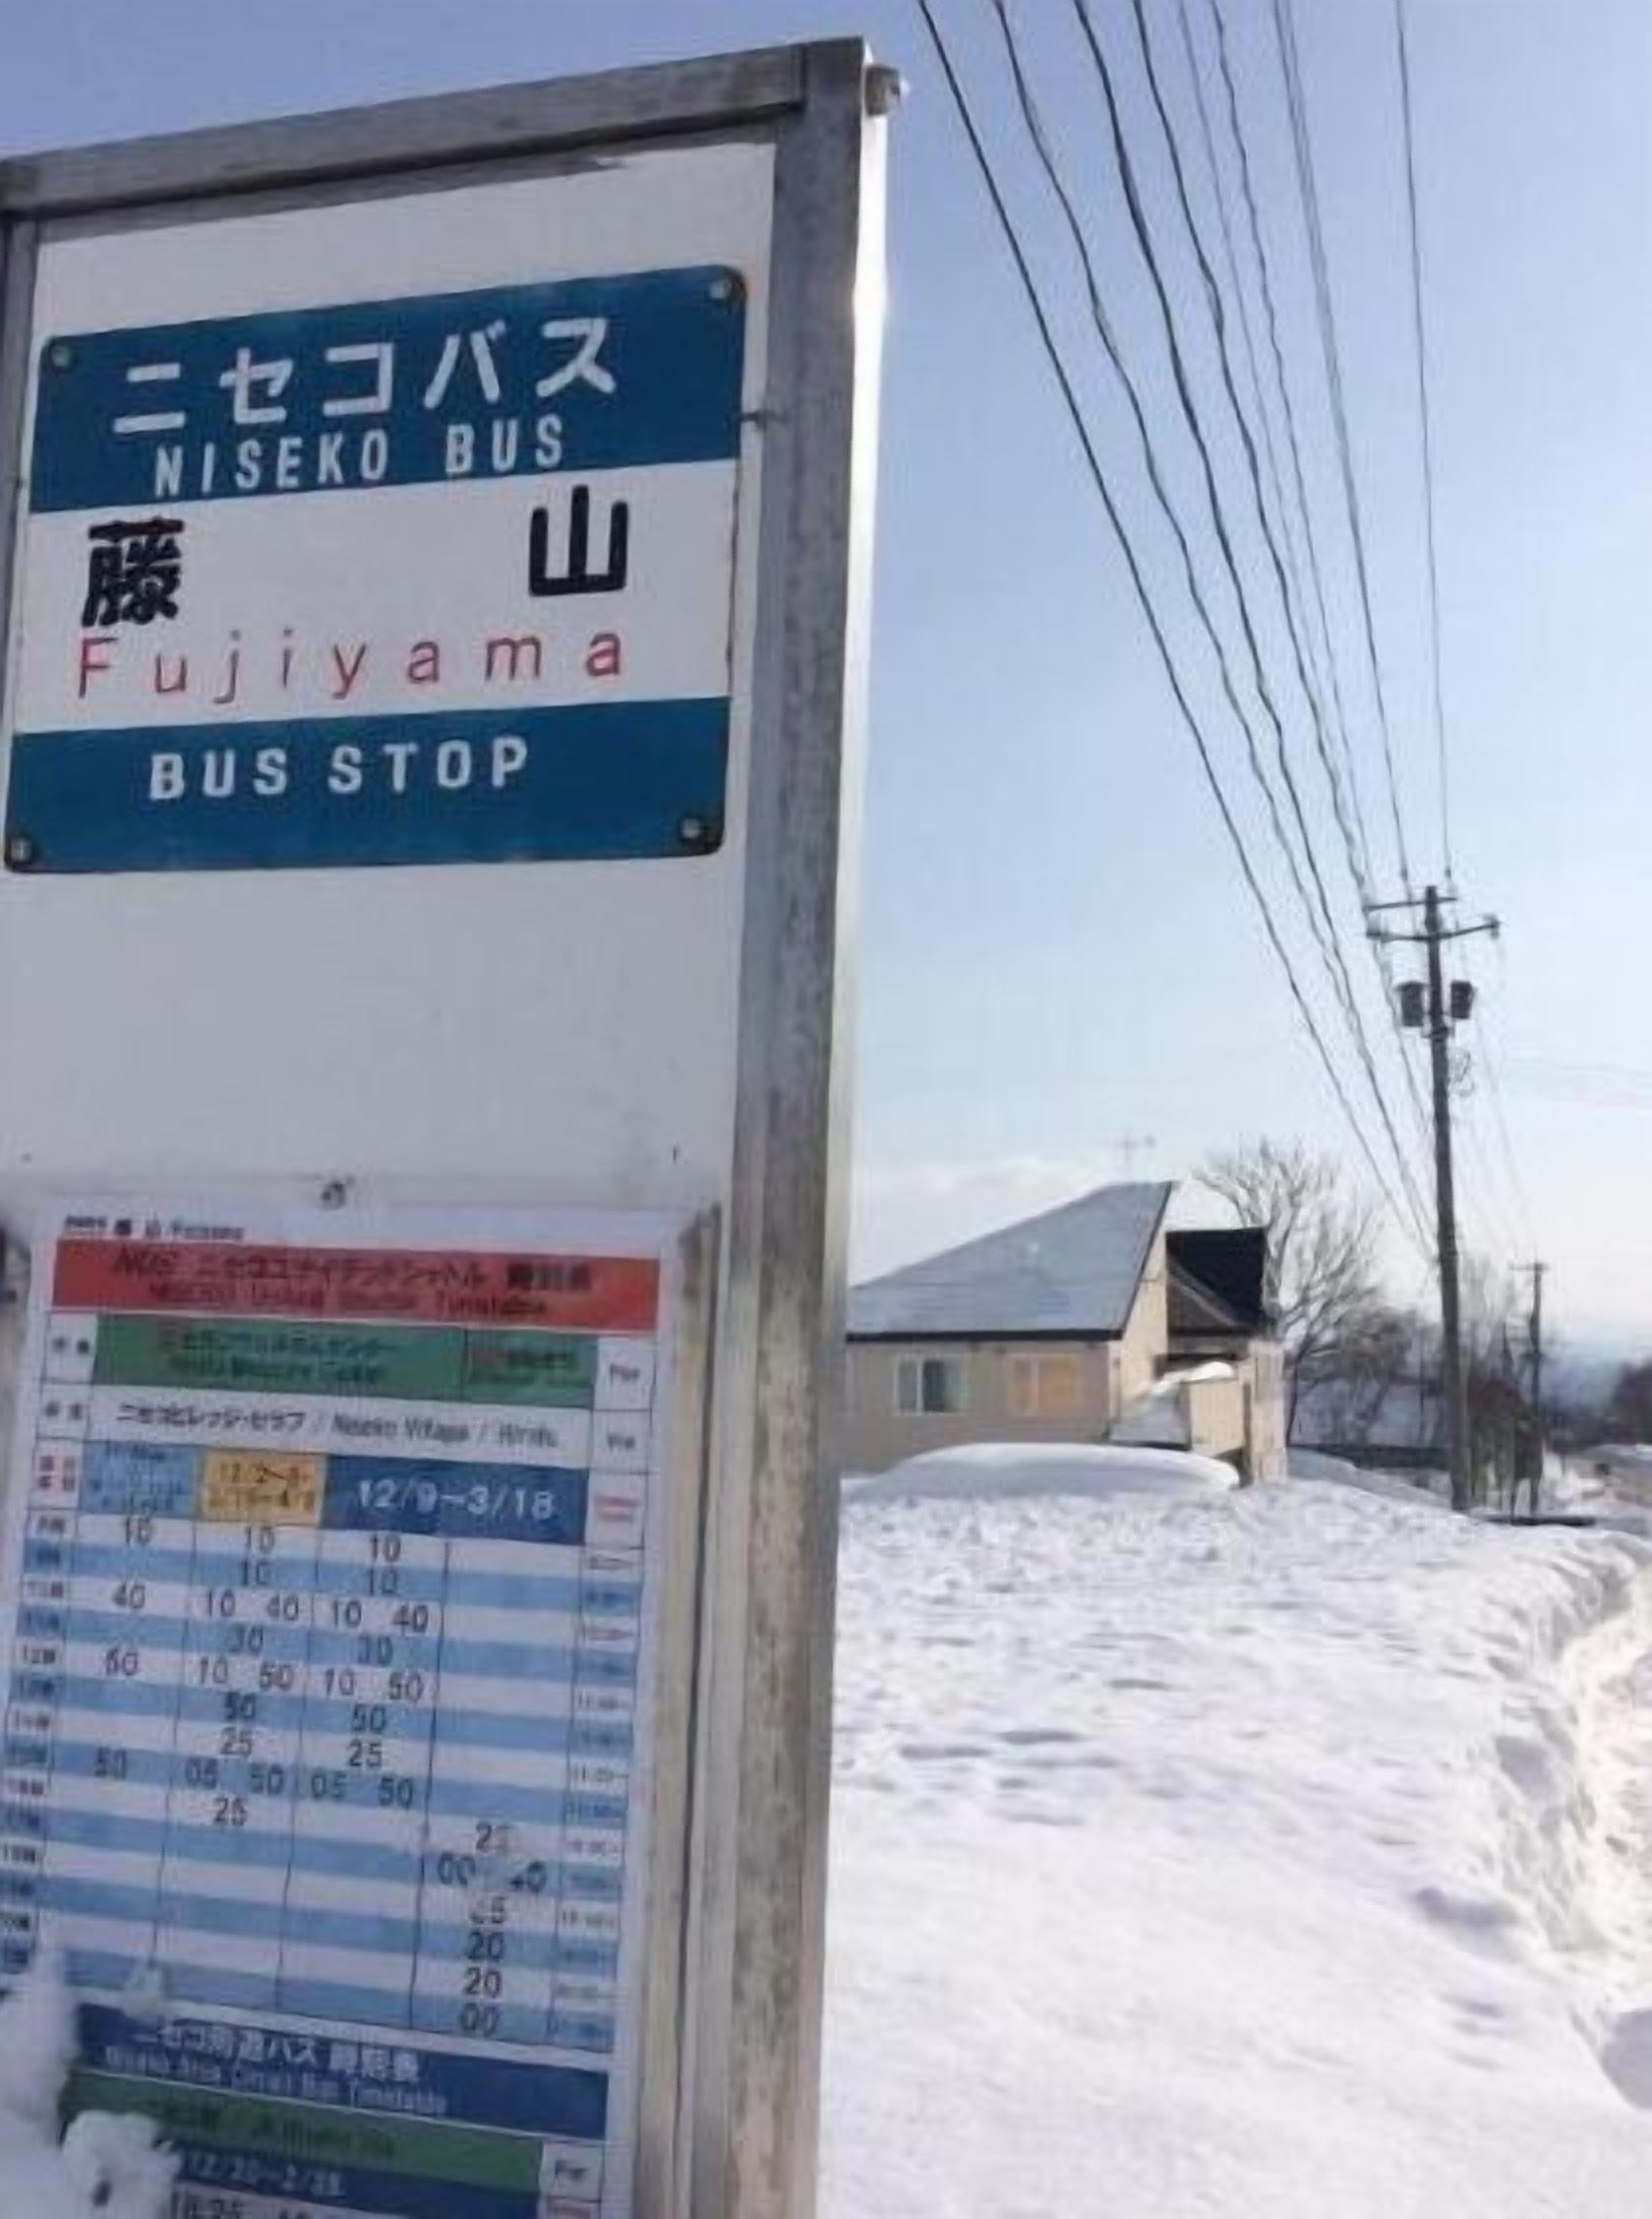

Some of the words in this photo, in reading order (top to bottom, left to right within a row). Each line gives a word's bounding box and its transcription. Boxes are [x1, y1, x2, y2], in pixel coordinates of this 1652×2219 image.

[114, 317, 617, 435] ニセコバス
[154, 429, 388, 498] NISEKO
[444, 414, 563, 475] BUS
[78, 630, 621, 706] Fujiyama
[149, 747, 288, 802] BUS
[327, 736, 528, 794] STOP
[246, 1527, 274, 1554] 10
[371, 1533, 401, 1563] 10
[113, 1583, 146, 1610] 40
[207, 1589, 236, 1617] 10
[332, 1600, 362, 1627] 10
[393, 1603, 429, 1637] 40
[199, 1657, 228, 1684] 10
[324, 1668, 355, 1696] 10
[352, 1704, 386, 1733] 50
[220, 1727, 253, 1756] 25
[347, 1739, 384, 1768] 25
[378, 1775, 414, 1808] 50
[468, 1931, 503, 1963] 20
[464, 1966, 502, 1999] 20
